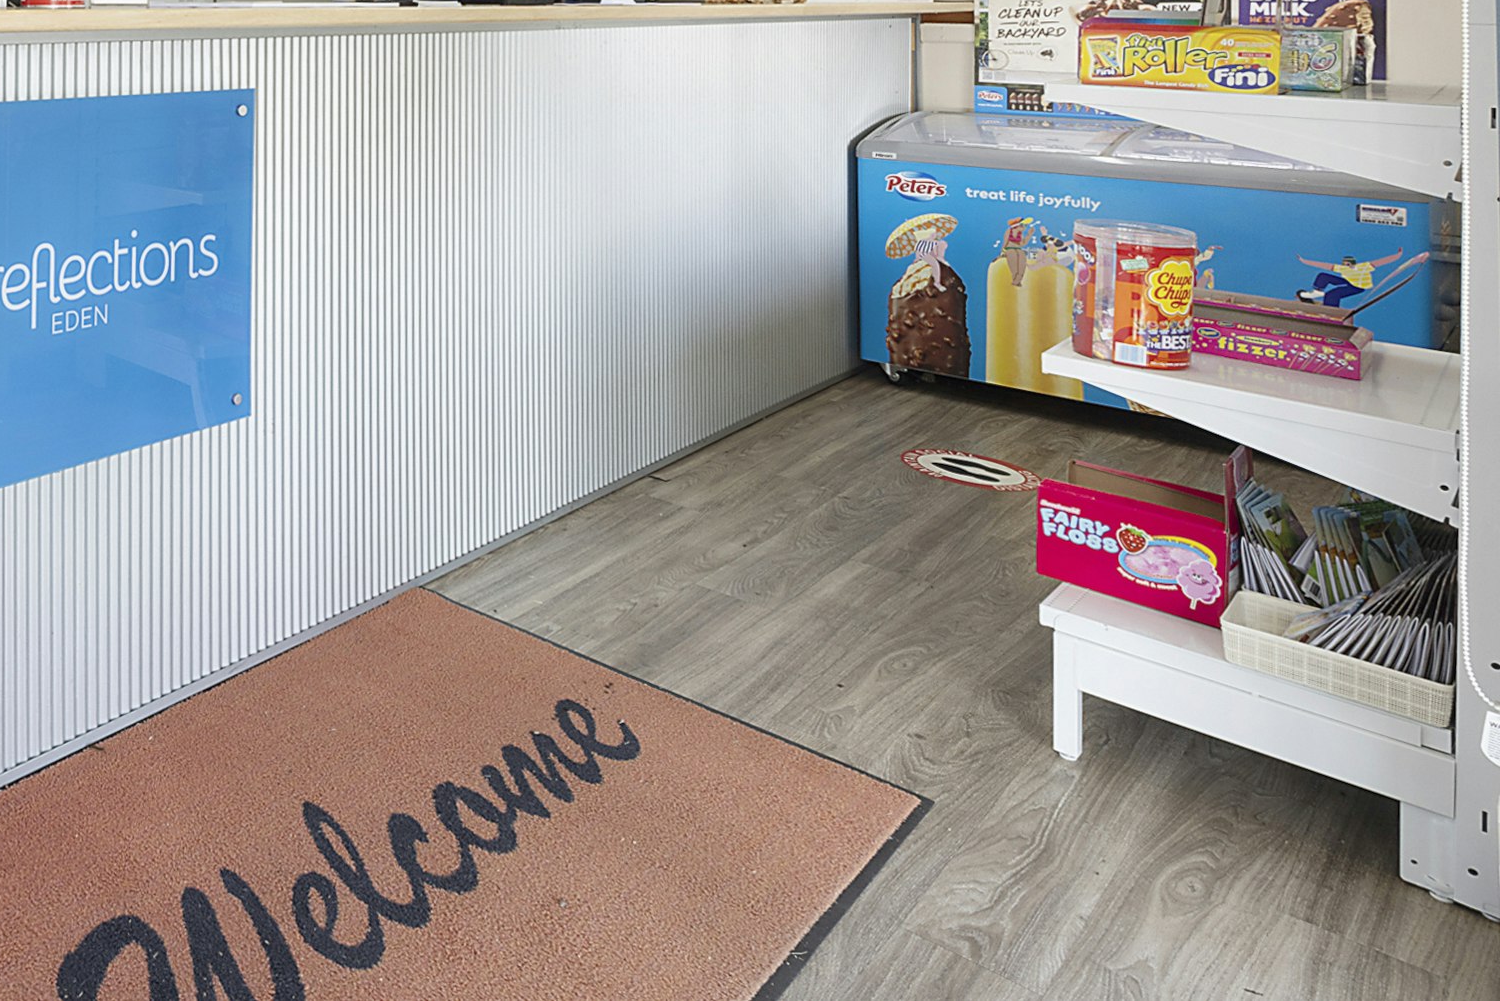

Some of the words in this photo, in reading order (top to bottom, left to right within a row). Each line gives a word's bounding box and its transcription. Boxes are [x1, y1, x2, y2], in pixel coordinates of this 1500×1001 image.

[998, 7, 1042, 19] CLEAN
[1043, 6, 1064, 18] UP
[1017, 0, 1044, 8] LET'S
[1249, 2, 1311, 17] MILK
[995, 27, 1067, 40] BACKYARD
[1018, 19, 1040, 27] OUR
[1122, 36, 1228, 77] Roller
[1213, 66, 1269, 87] Fini
[886, 174, 946, 197] Peters
[965, 186, 1007, 202] treat
[1009, 189, 1035, 204] life
[1037, 193, 1102, 213] joyfully
[51, 303, 110, 335] EDEN
[1217, 336, 1289, 360] fizzer
[1040, 507, 1111, 536] FAIRY
[1042, 521, 1120, 553] FLOSS
[56, 697, 640, 1001] Welcome
